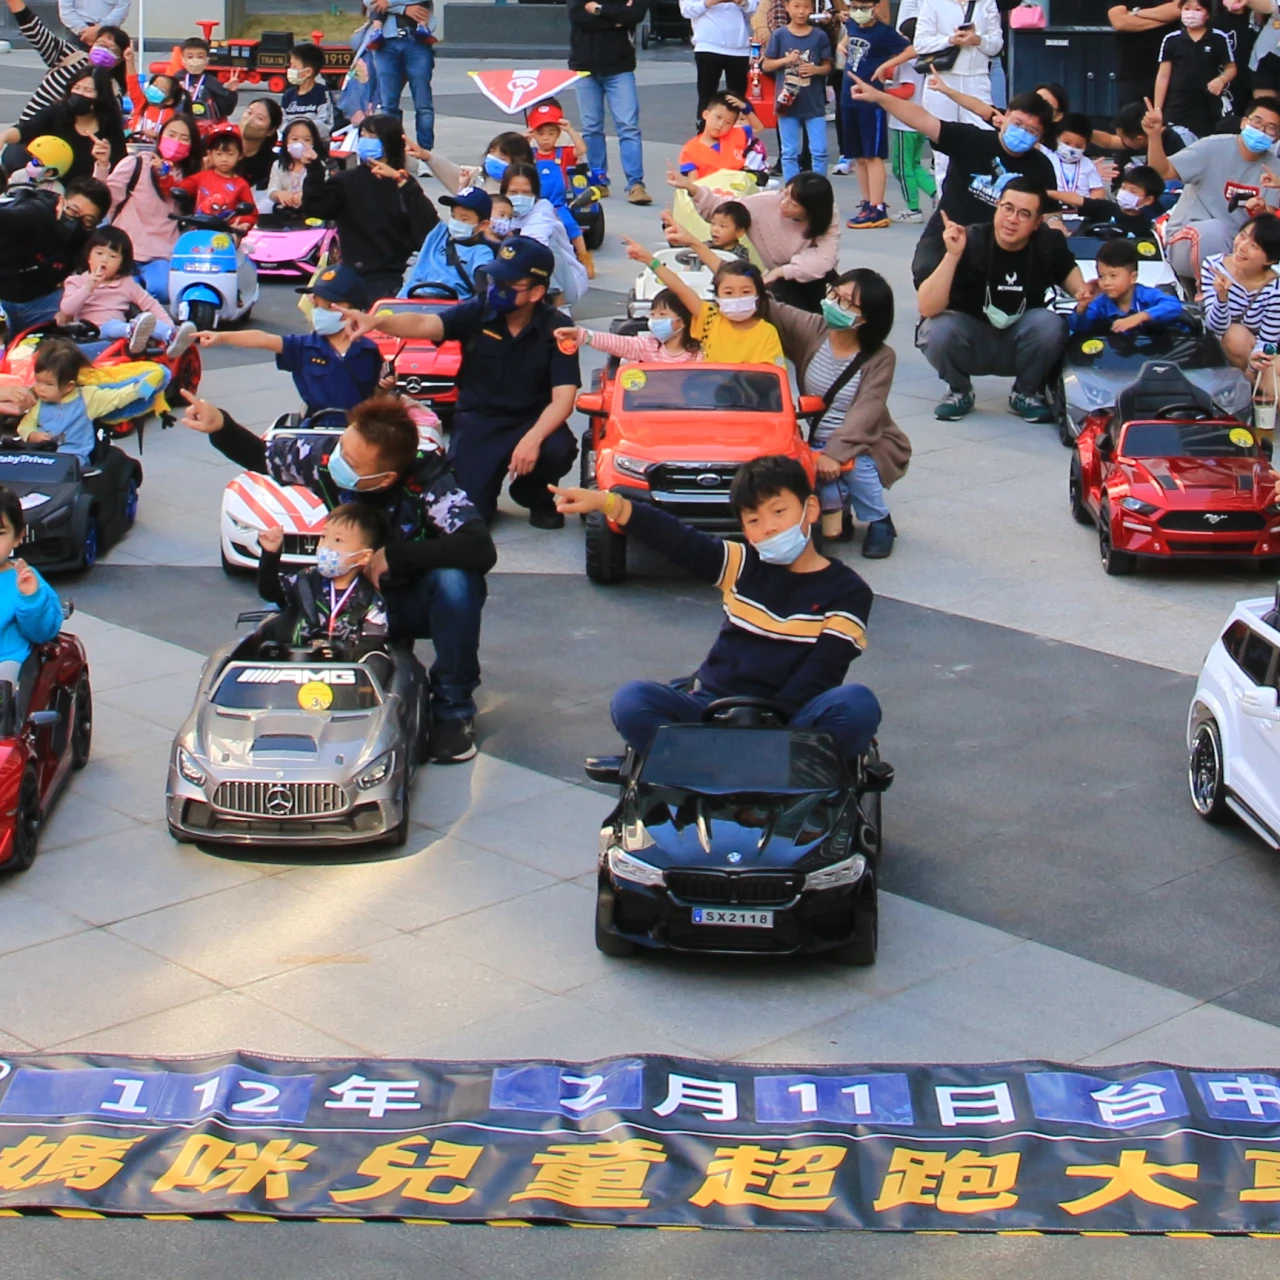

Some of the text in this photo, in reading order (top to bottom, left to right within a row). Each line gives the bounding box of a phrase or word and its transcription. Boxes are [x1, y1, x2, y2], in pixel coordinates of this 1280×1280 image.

[260, 55, 286, 65] TRAIN
[324, 53, 351, 65] 1919
[277, 668, 356, 685] AMG
[705, 909, 769, 926] SX2118
